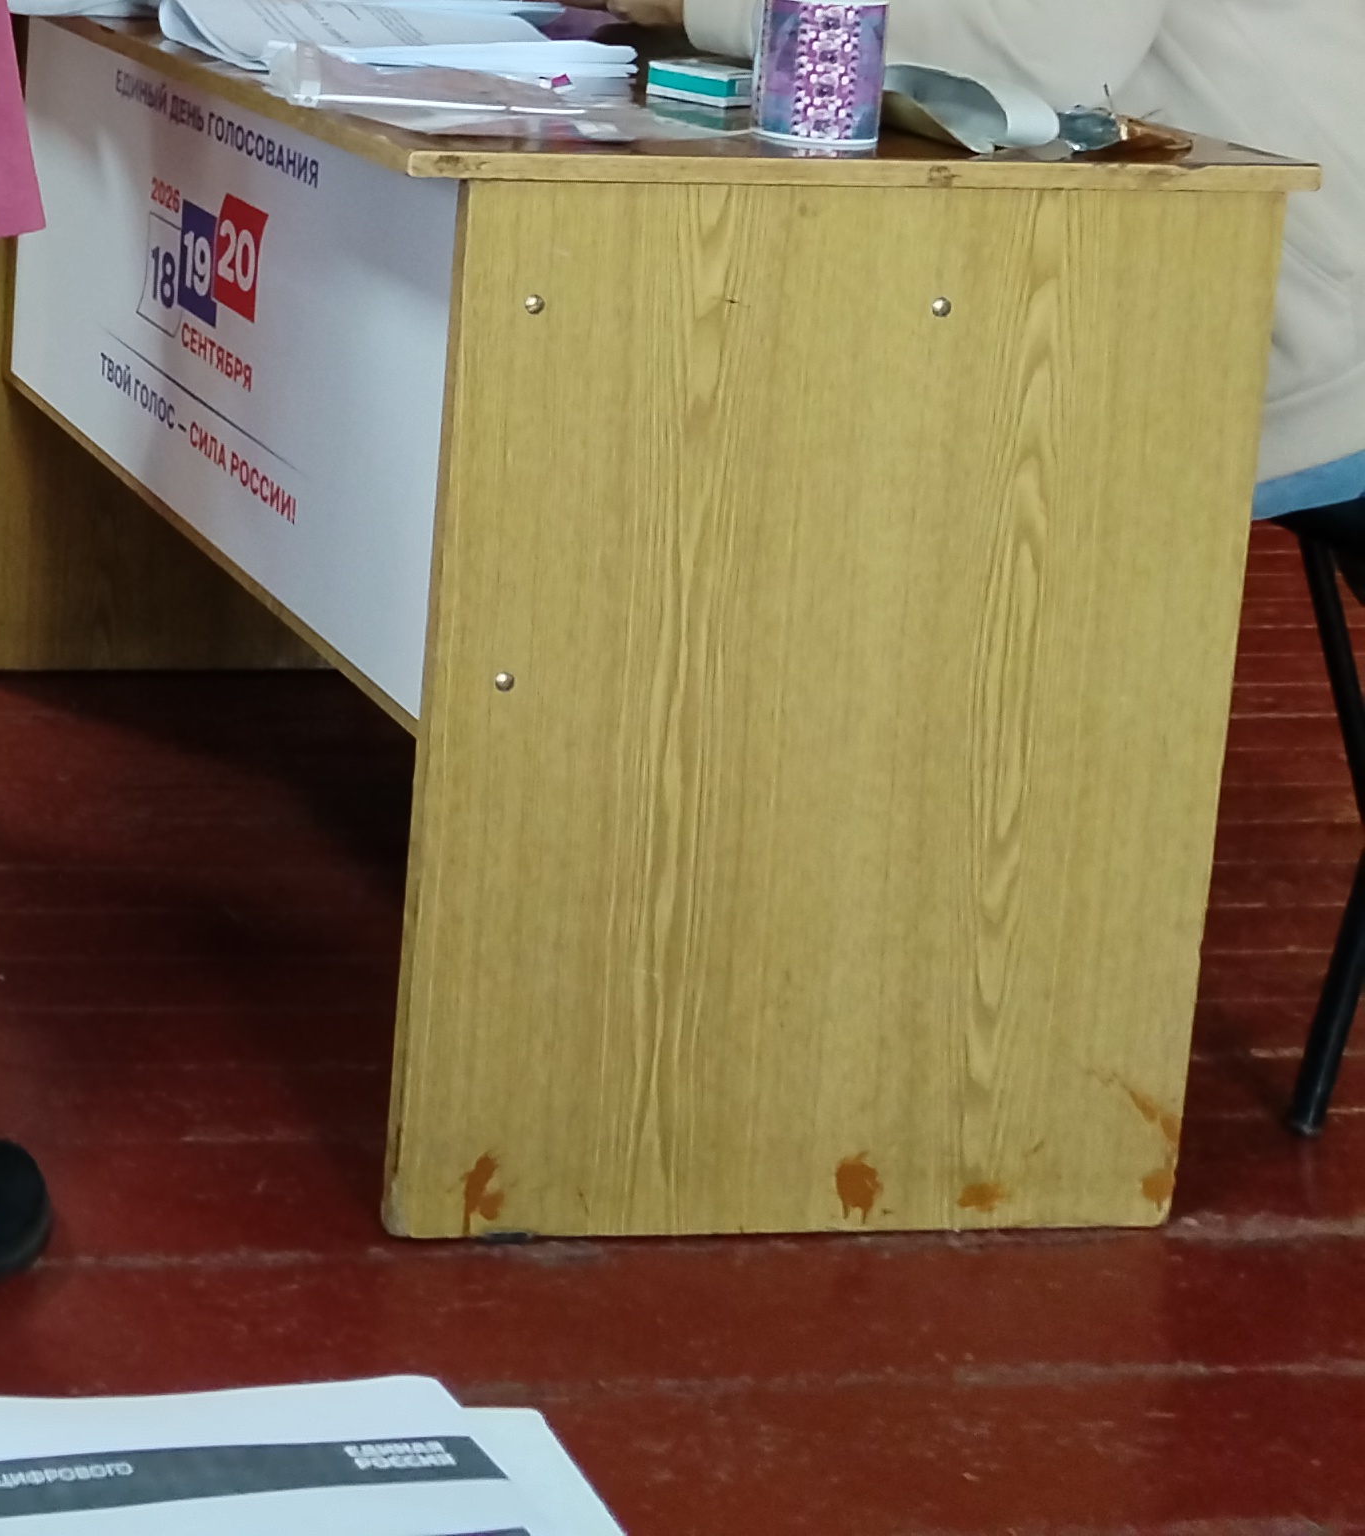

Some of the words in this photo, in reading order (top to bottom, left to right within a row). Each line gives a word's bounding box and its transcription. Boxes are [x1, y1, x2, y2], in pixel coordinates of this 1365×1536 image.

[115, 70, 167, 113] ЕДИНЫЙ
[169, 93, 204, 132] ДЕНЬ
[207, 112, 320, 189] ГОЛОСОВАНИЯ
[149, 177, 181, 213] 2026
[150, 245, 176, 309] 18
[183, 230, 212, 297] 19
[217, 219, 256, 292] 20
[180, 322, 253, 393] СЕНТЯБРЯ
[100, 352, 131, 396] ТВОЙ
[133, 378, 176, 430] ГОЛОС
[189, 420, 227, 471] СИЛА
[230, 451, 297, 525] РОССИИ!
